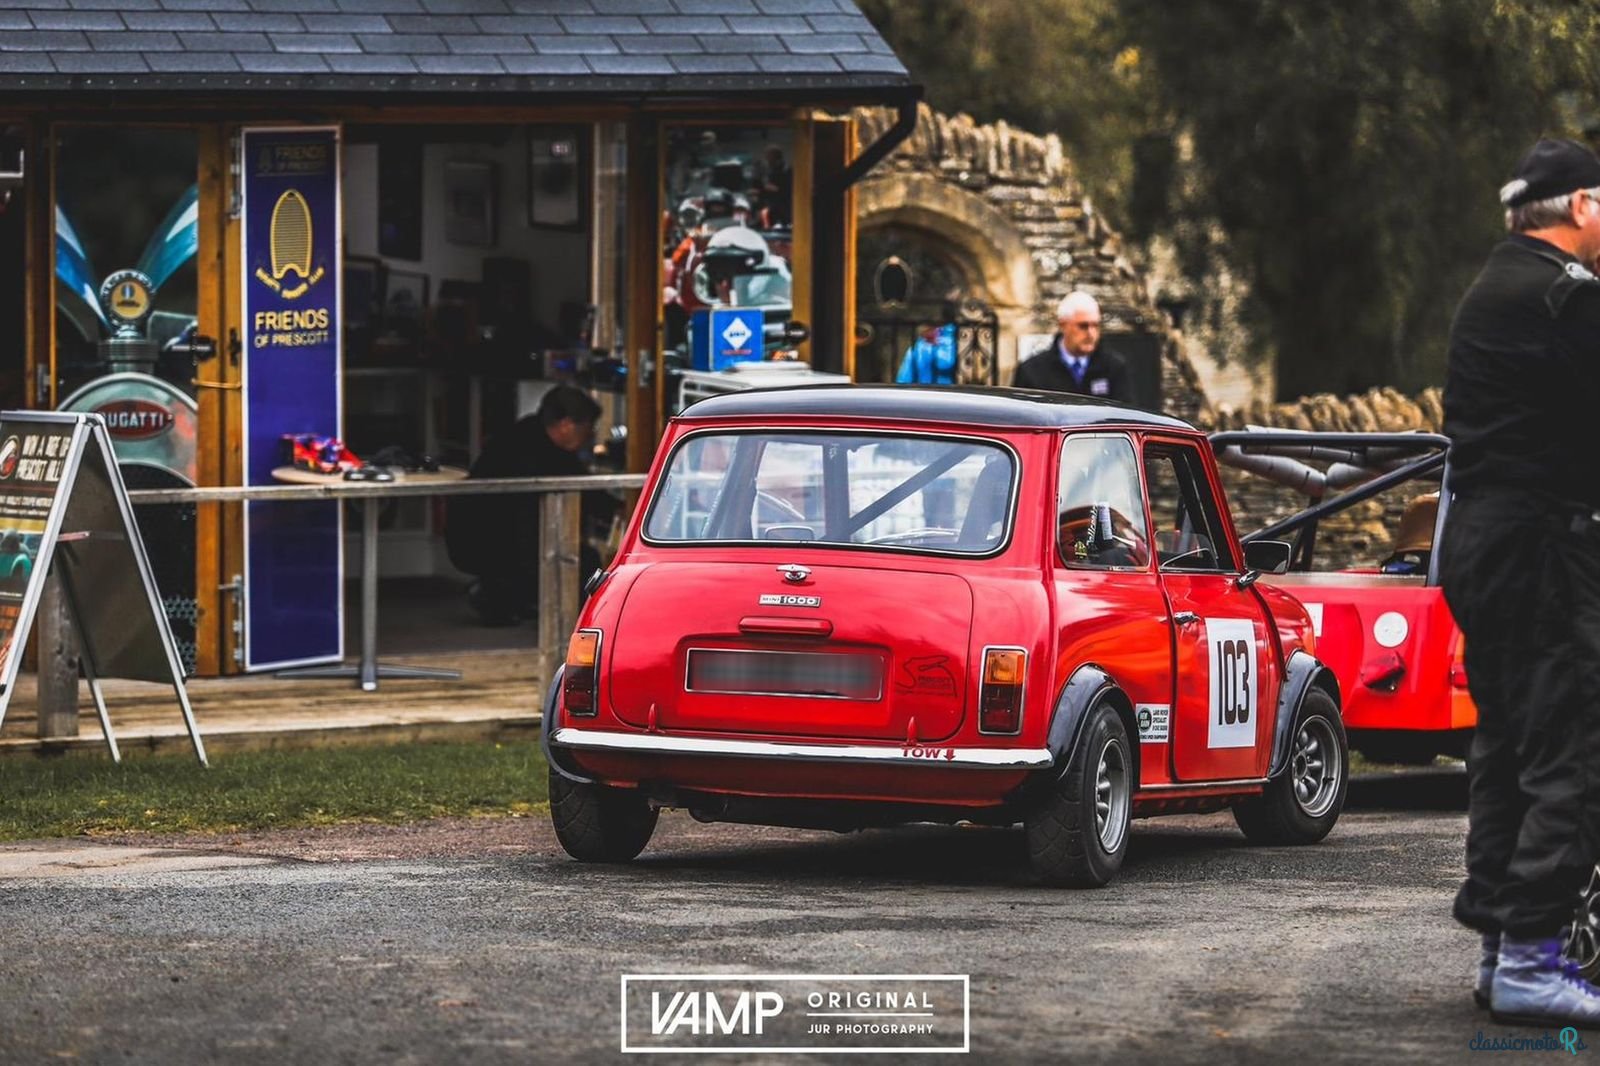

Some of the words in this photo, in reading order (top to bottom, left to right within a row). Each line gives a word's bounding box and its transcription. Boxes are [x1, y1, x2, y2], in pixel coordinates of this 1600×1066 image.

[255, 308, 329, 331] FRIENDS
[254, 333, 269, 349] OF
[272, 330, 328, 346] PRESCOTT
[783, 596, 817, 605] 1000
[1217, 639, 1250, 726] 103
[901, 747, 941, 759] TOW
